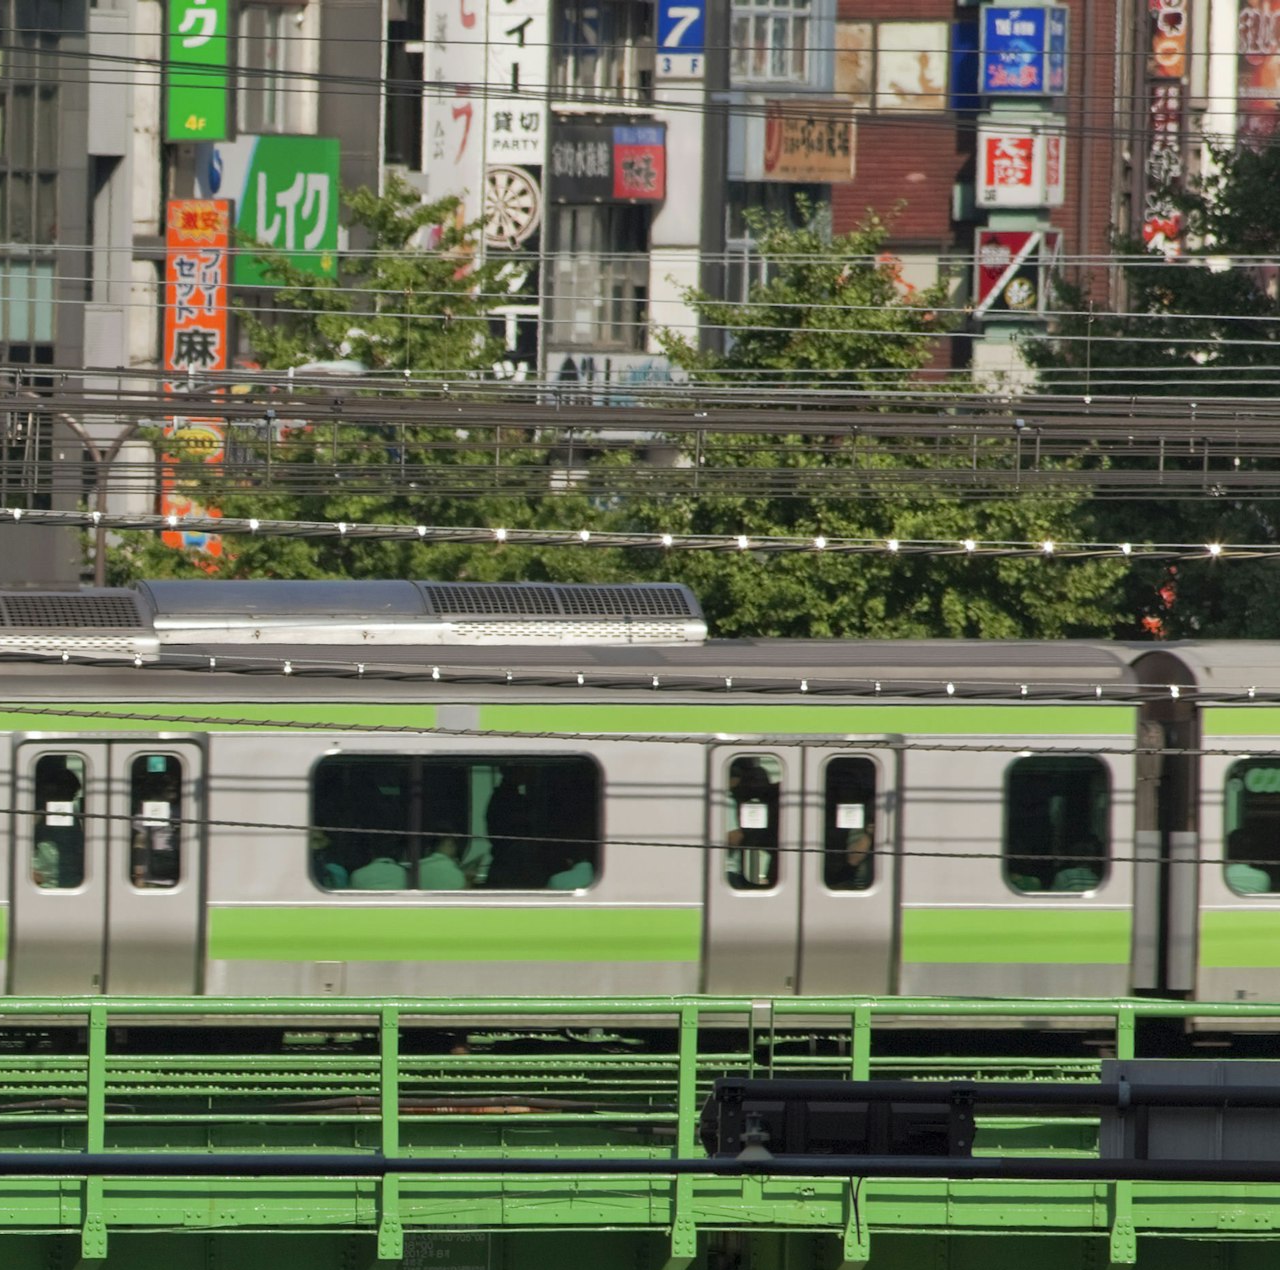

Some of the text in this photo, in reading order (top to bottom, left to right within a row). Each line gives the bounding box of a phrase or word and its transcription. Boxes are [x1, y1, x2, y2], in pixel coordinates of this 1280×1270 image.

[663, 7, 700, 47] 7
[184, 116, 207, 131] 4F
[494, 111, 540, 133] 貸切
[493, 139, 539, 150] PARTY
[255, 172, 331, 250] レイク
[174, 257, 197, 321] セット
[201, 247, 221, 314] フリー
